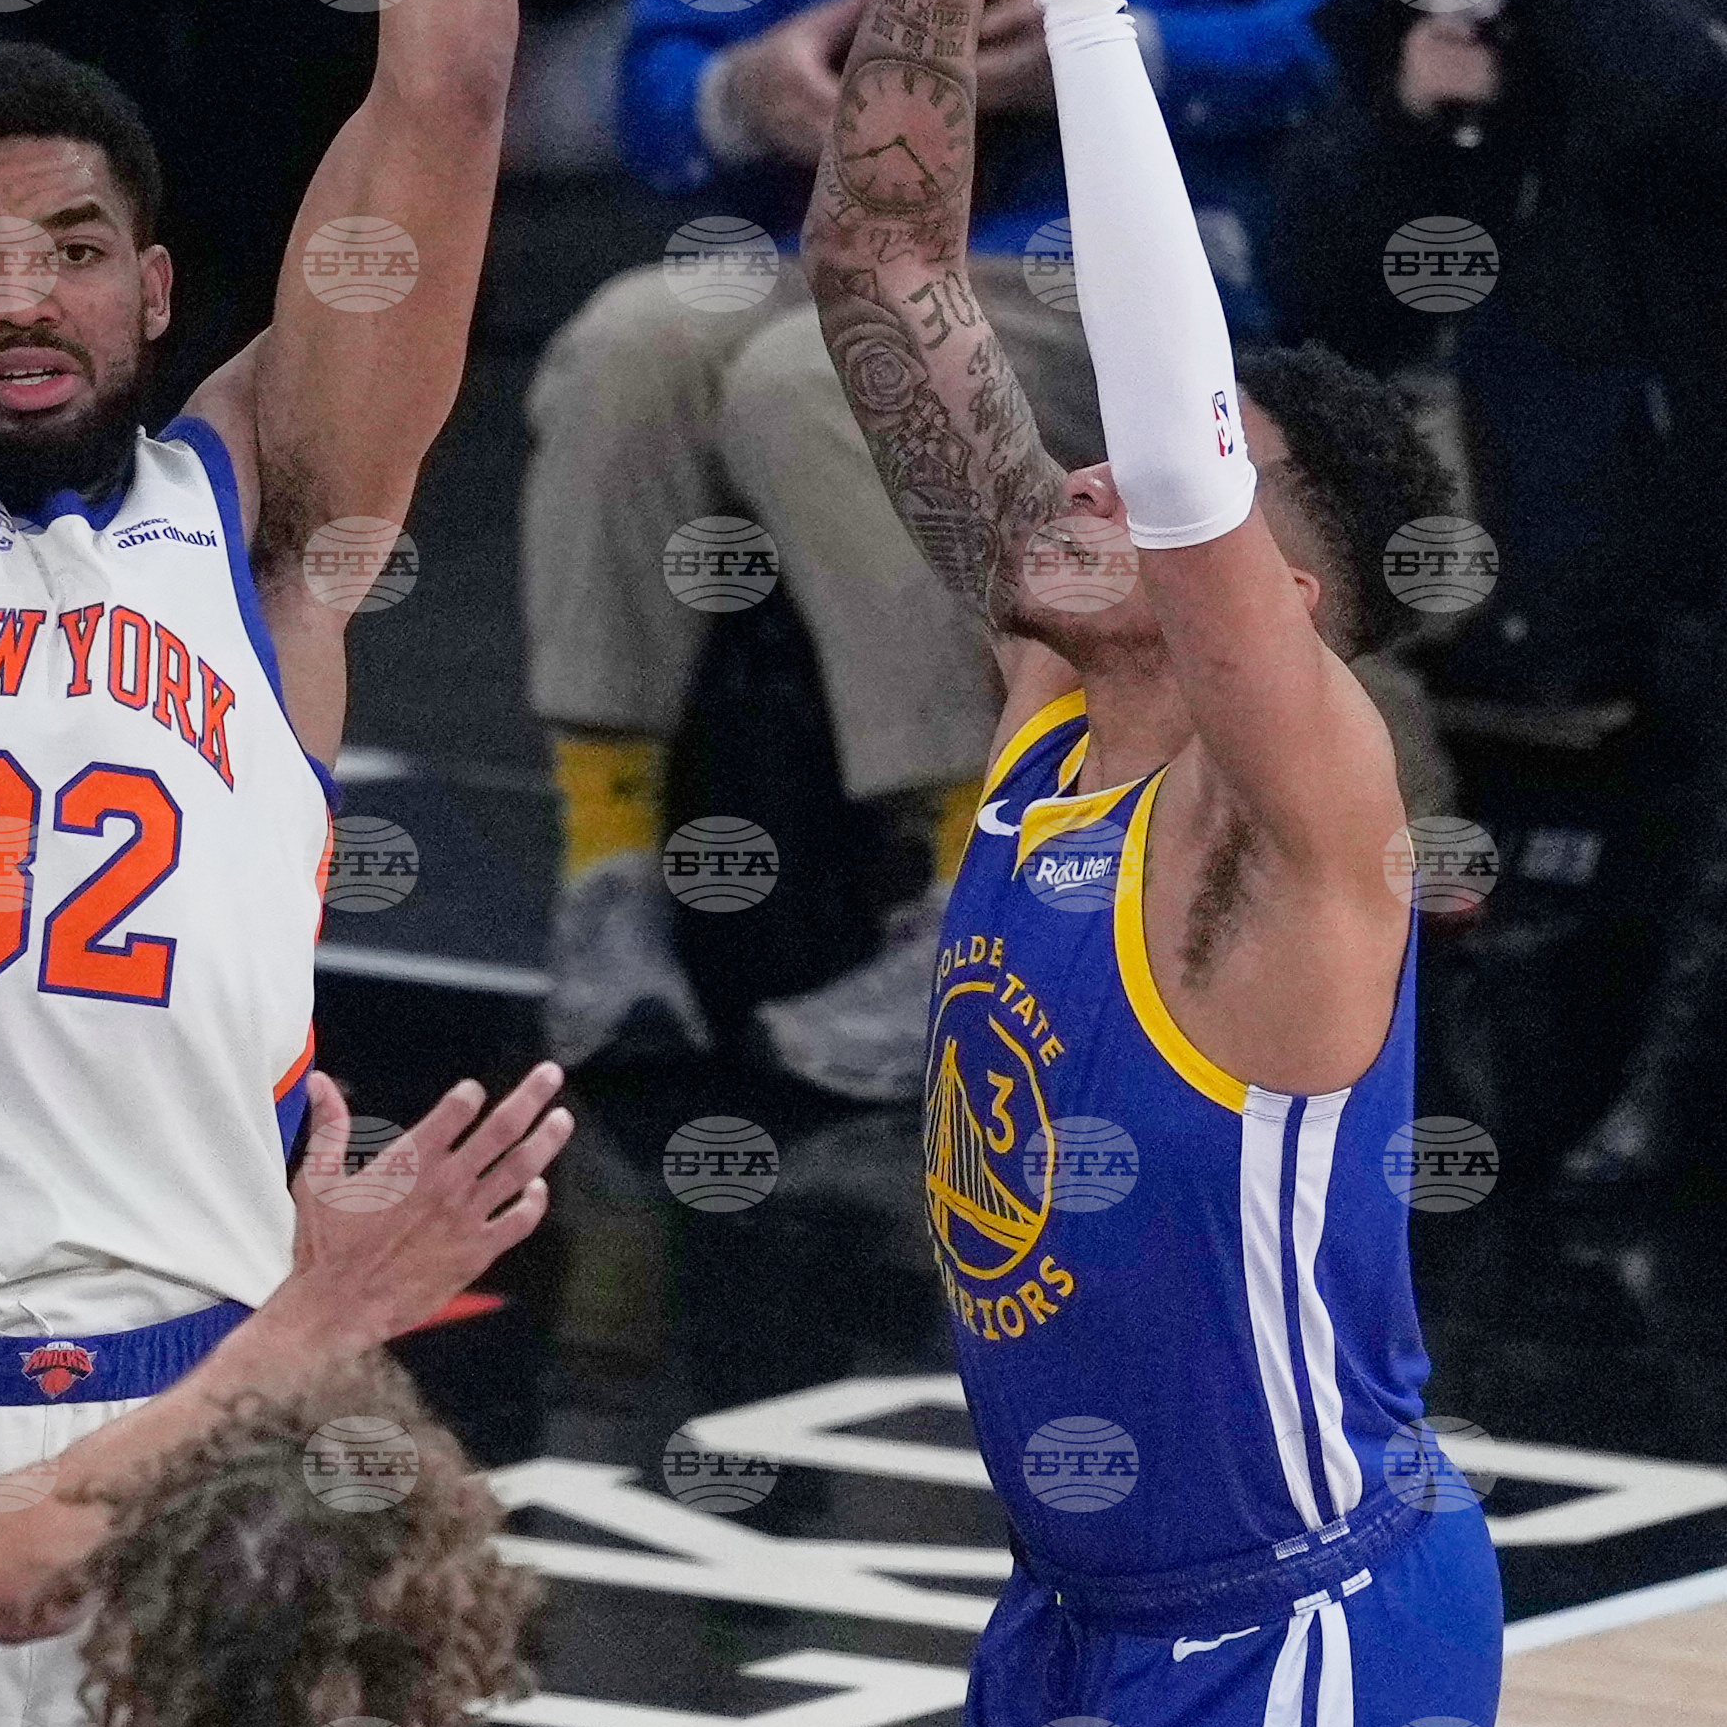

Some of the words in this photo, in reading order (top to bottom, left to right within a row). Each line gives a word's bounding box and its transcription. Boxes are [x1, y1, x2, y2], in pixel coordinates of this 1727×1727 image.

[117, 529, 161, 549] abu
[162, 526, 218, 547] dhabi
[58, 602, 236, 793] YORK
[1035, 855, 1113, 886] Rakuten
[986, 1069, 1015, 1155] 3
